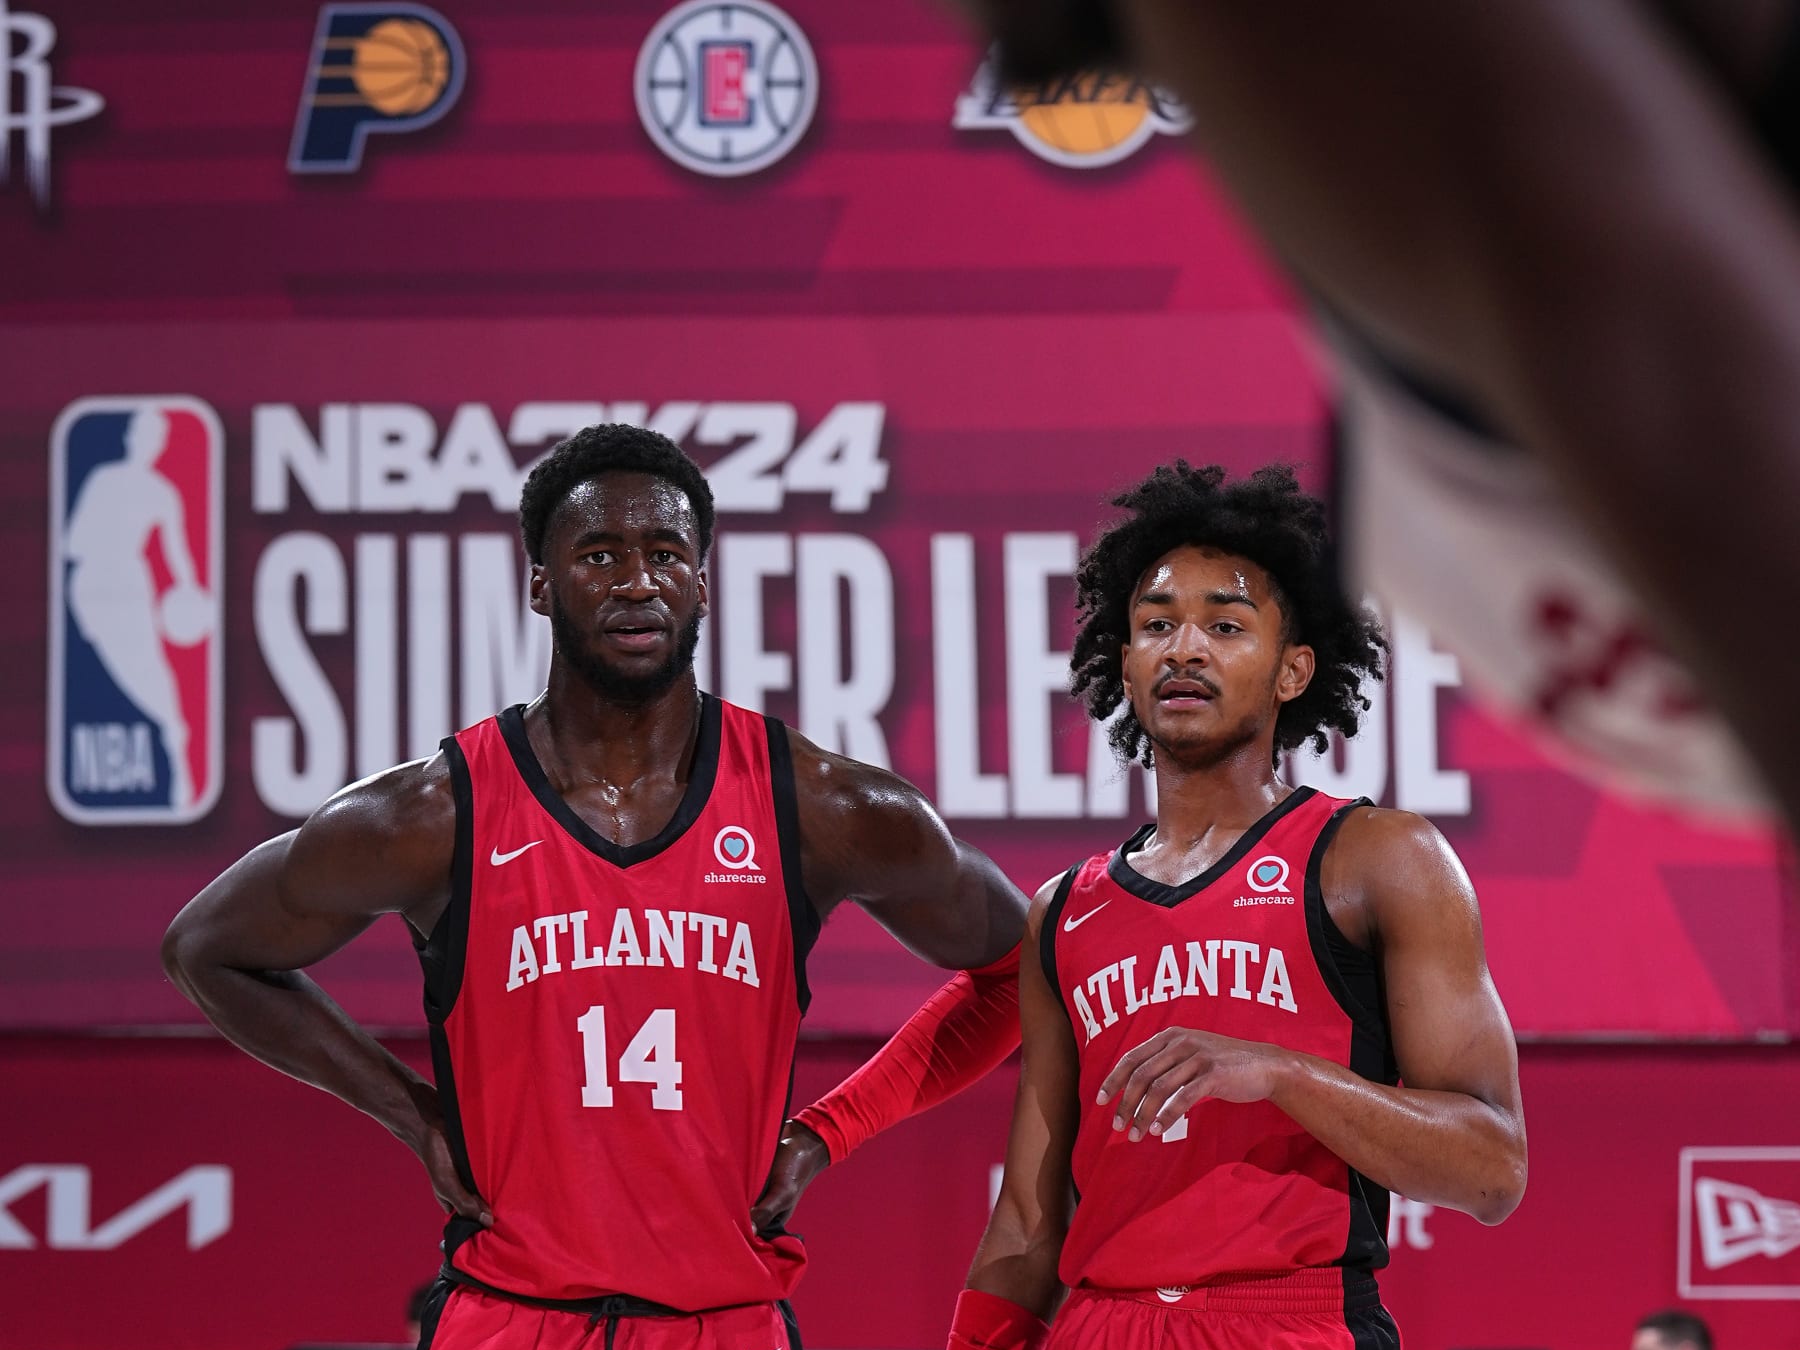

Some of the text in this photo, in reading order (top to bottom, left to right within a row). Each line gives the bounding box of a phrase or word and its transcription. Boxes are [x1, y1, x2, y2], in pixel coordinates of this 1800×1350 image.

[252, 532, 895, 817] SUMER
[71, 723, 156, 794] NBA
[704, 872, 766, 884] sharecare
[1233, 895, 1295, 908] sharecare
[506, 908, 760, 992] ATLANTA
[1072, 940, 1298, 1048] ATLANTA
[577, 1005, 683, 1111] 14
